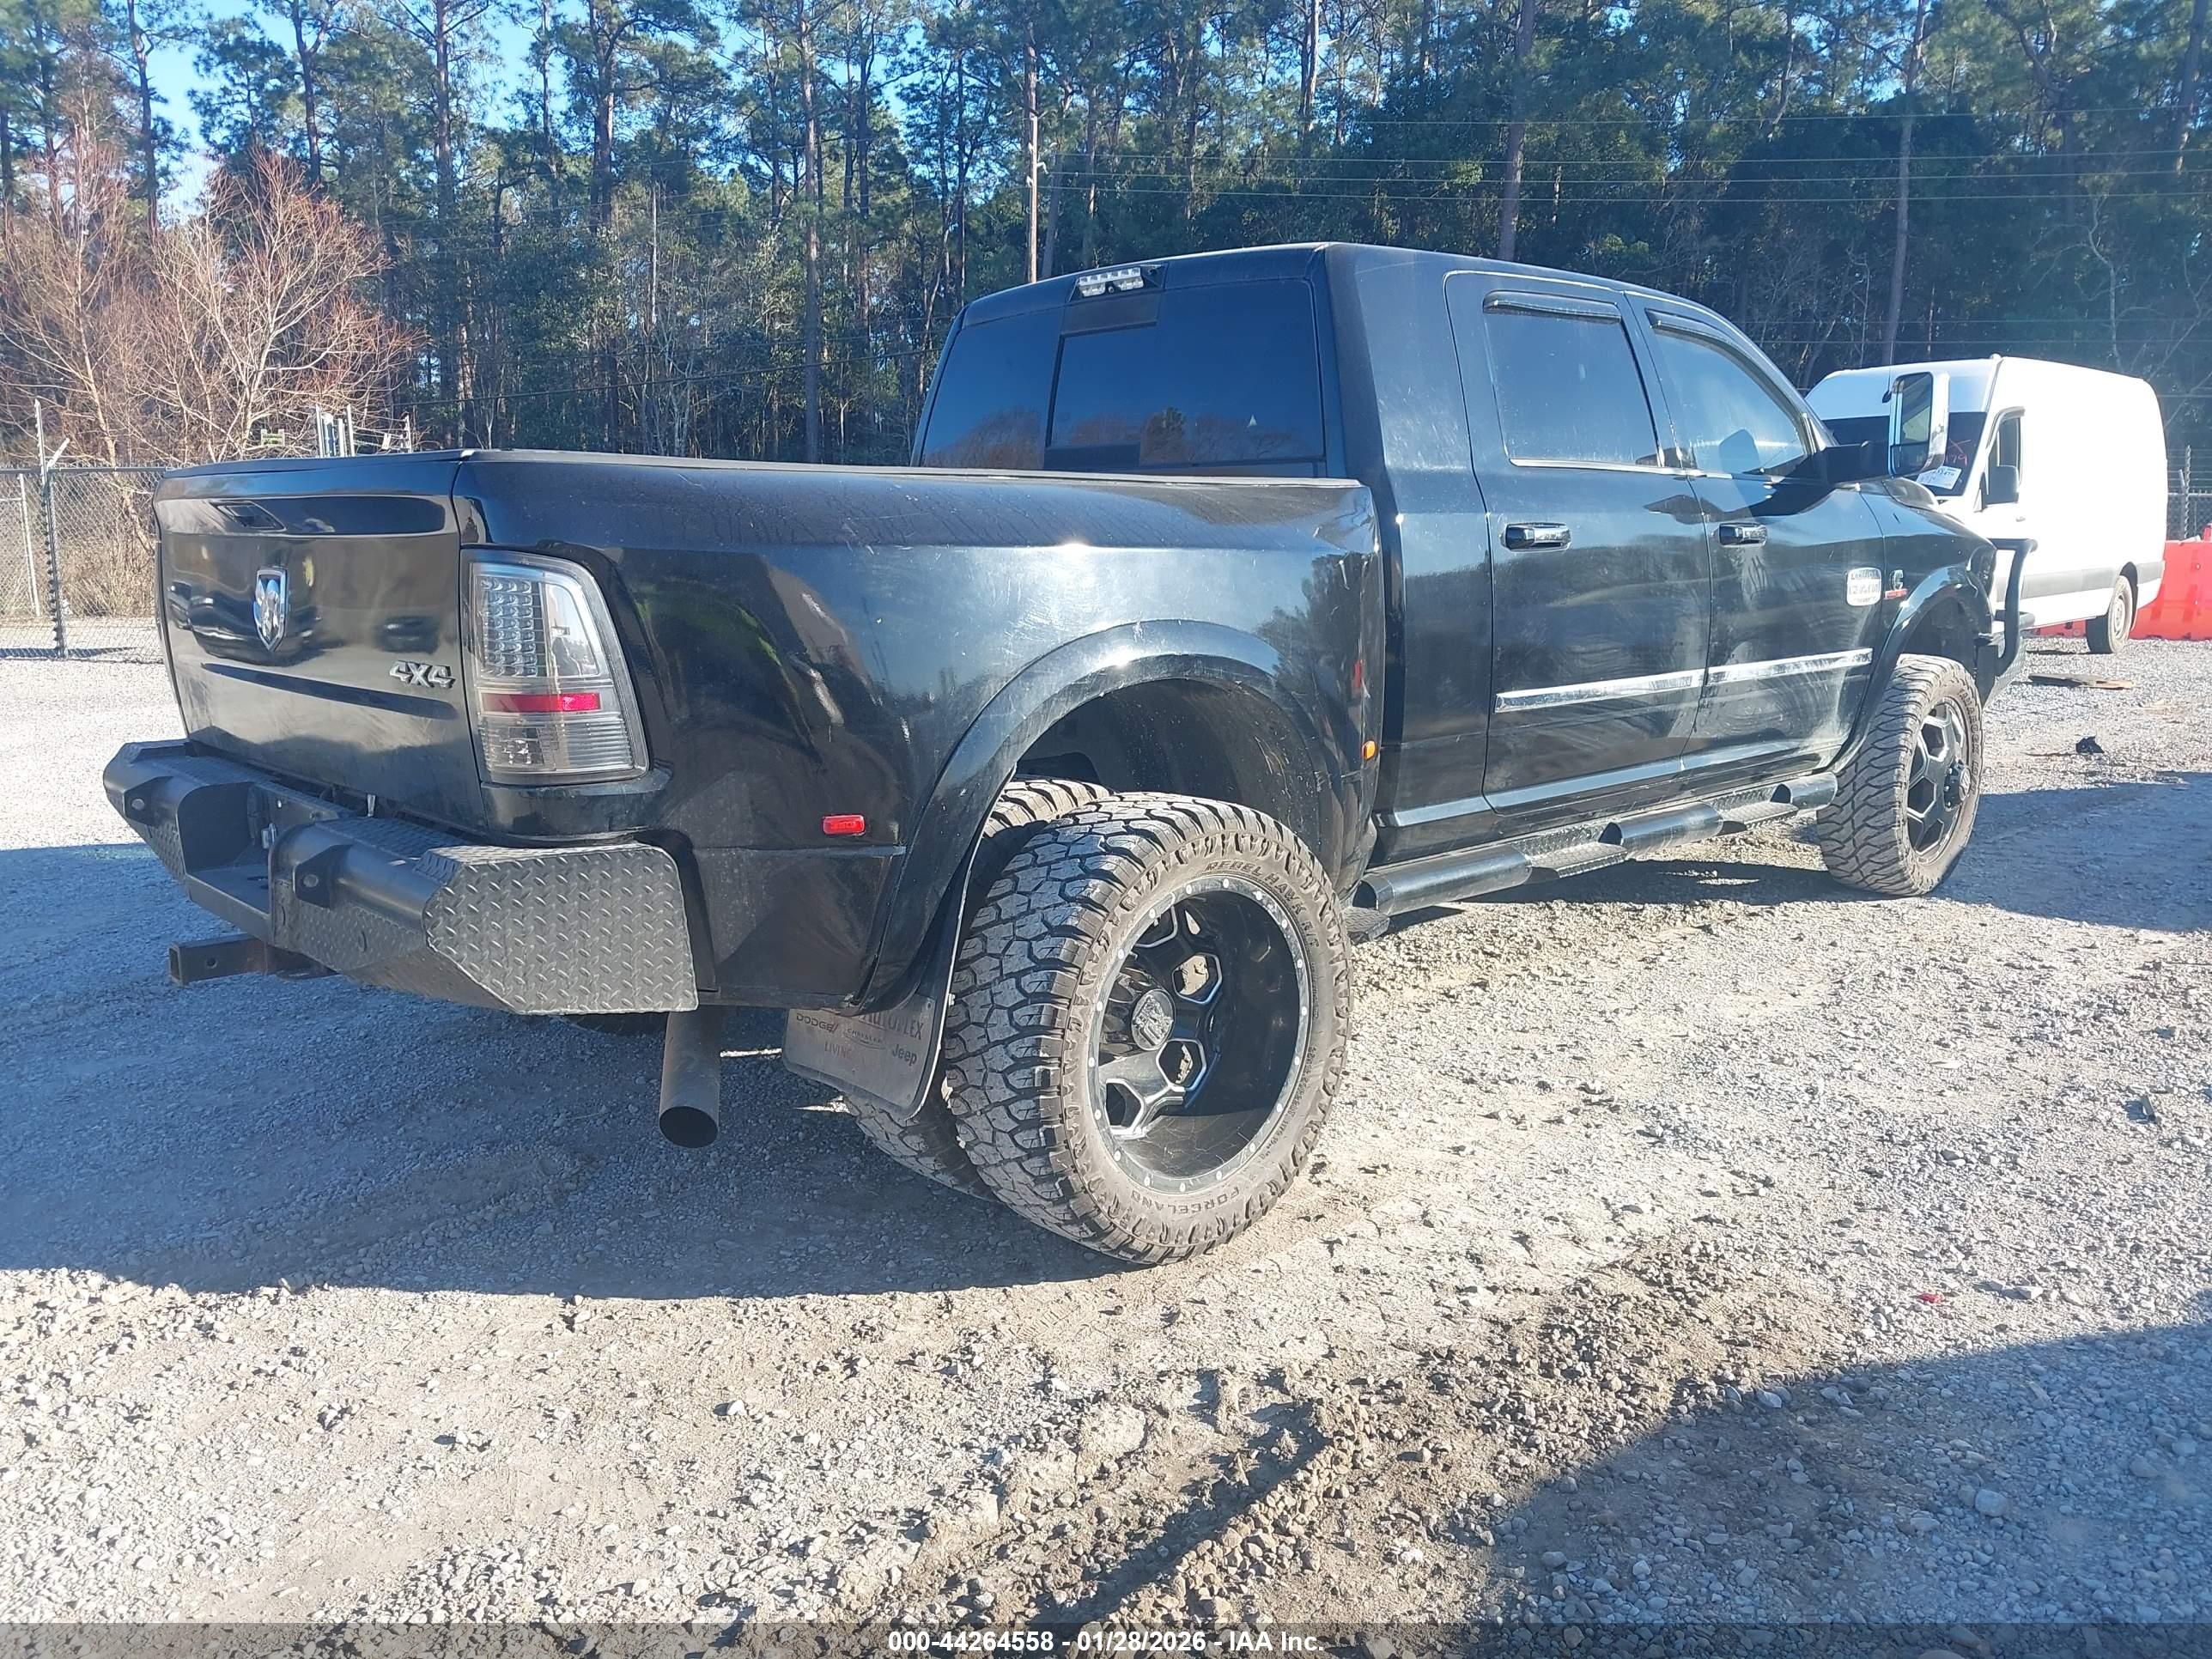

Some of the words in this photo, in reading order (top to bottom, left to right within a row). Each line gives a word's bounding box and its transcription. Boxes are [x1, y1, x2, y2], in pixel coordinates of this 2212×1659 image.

[1205, 860, 1263, 877] REBEL
[1264, 872, 1306, 915] HAWK
[892, 1043, 917, 1066] Jeep
[1131, 1186, 1240, 1214] FORCELAND
